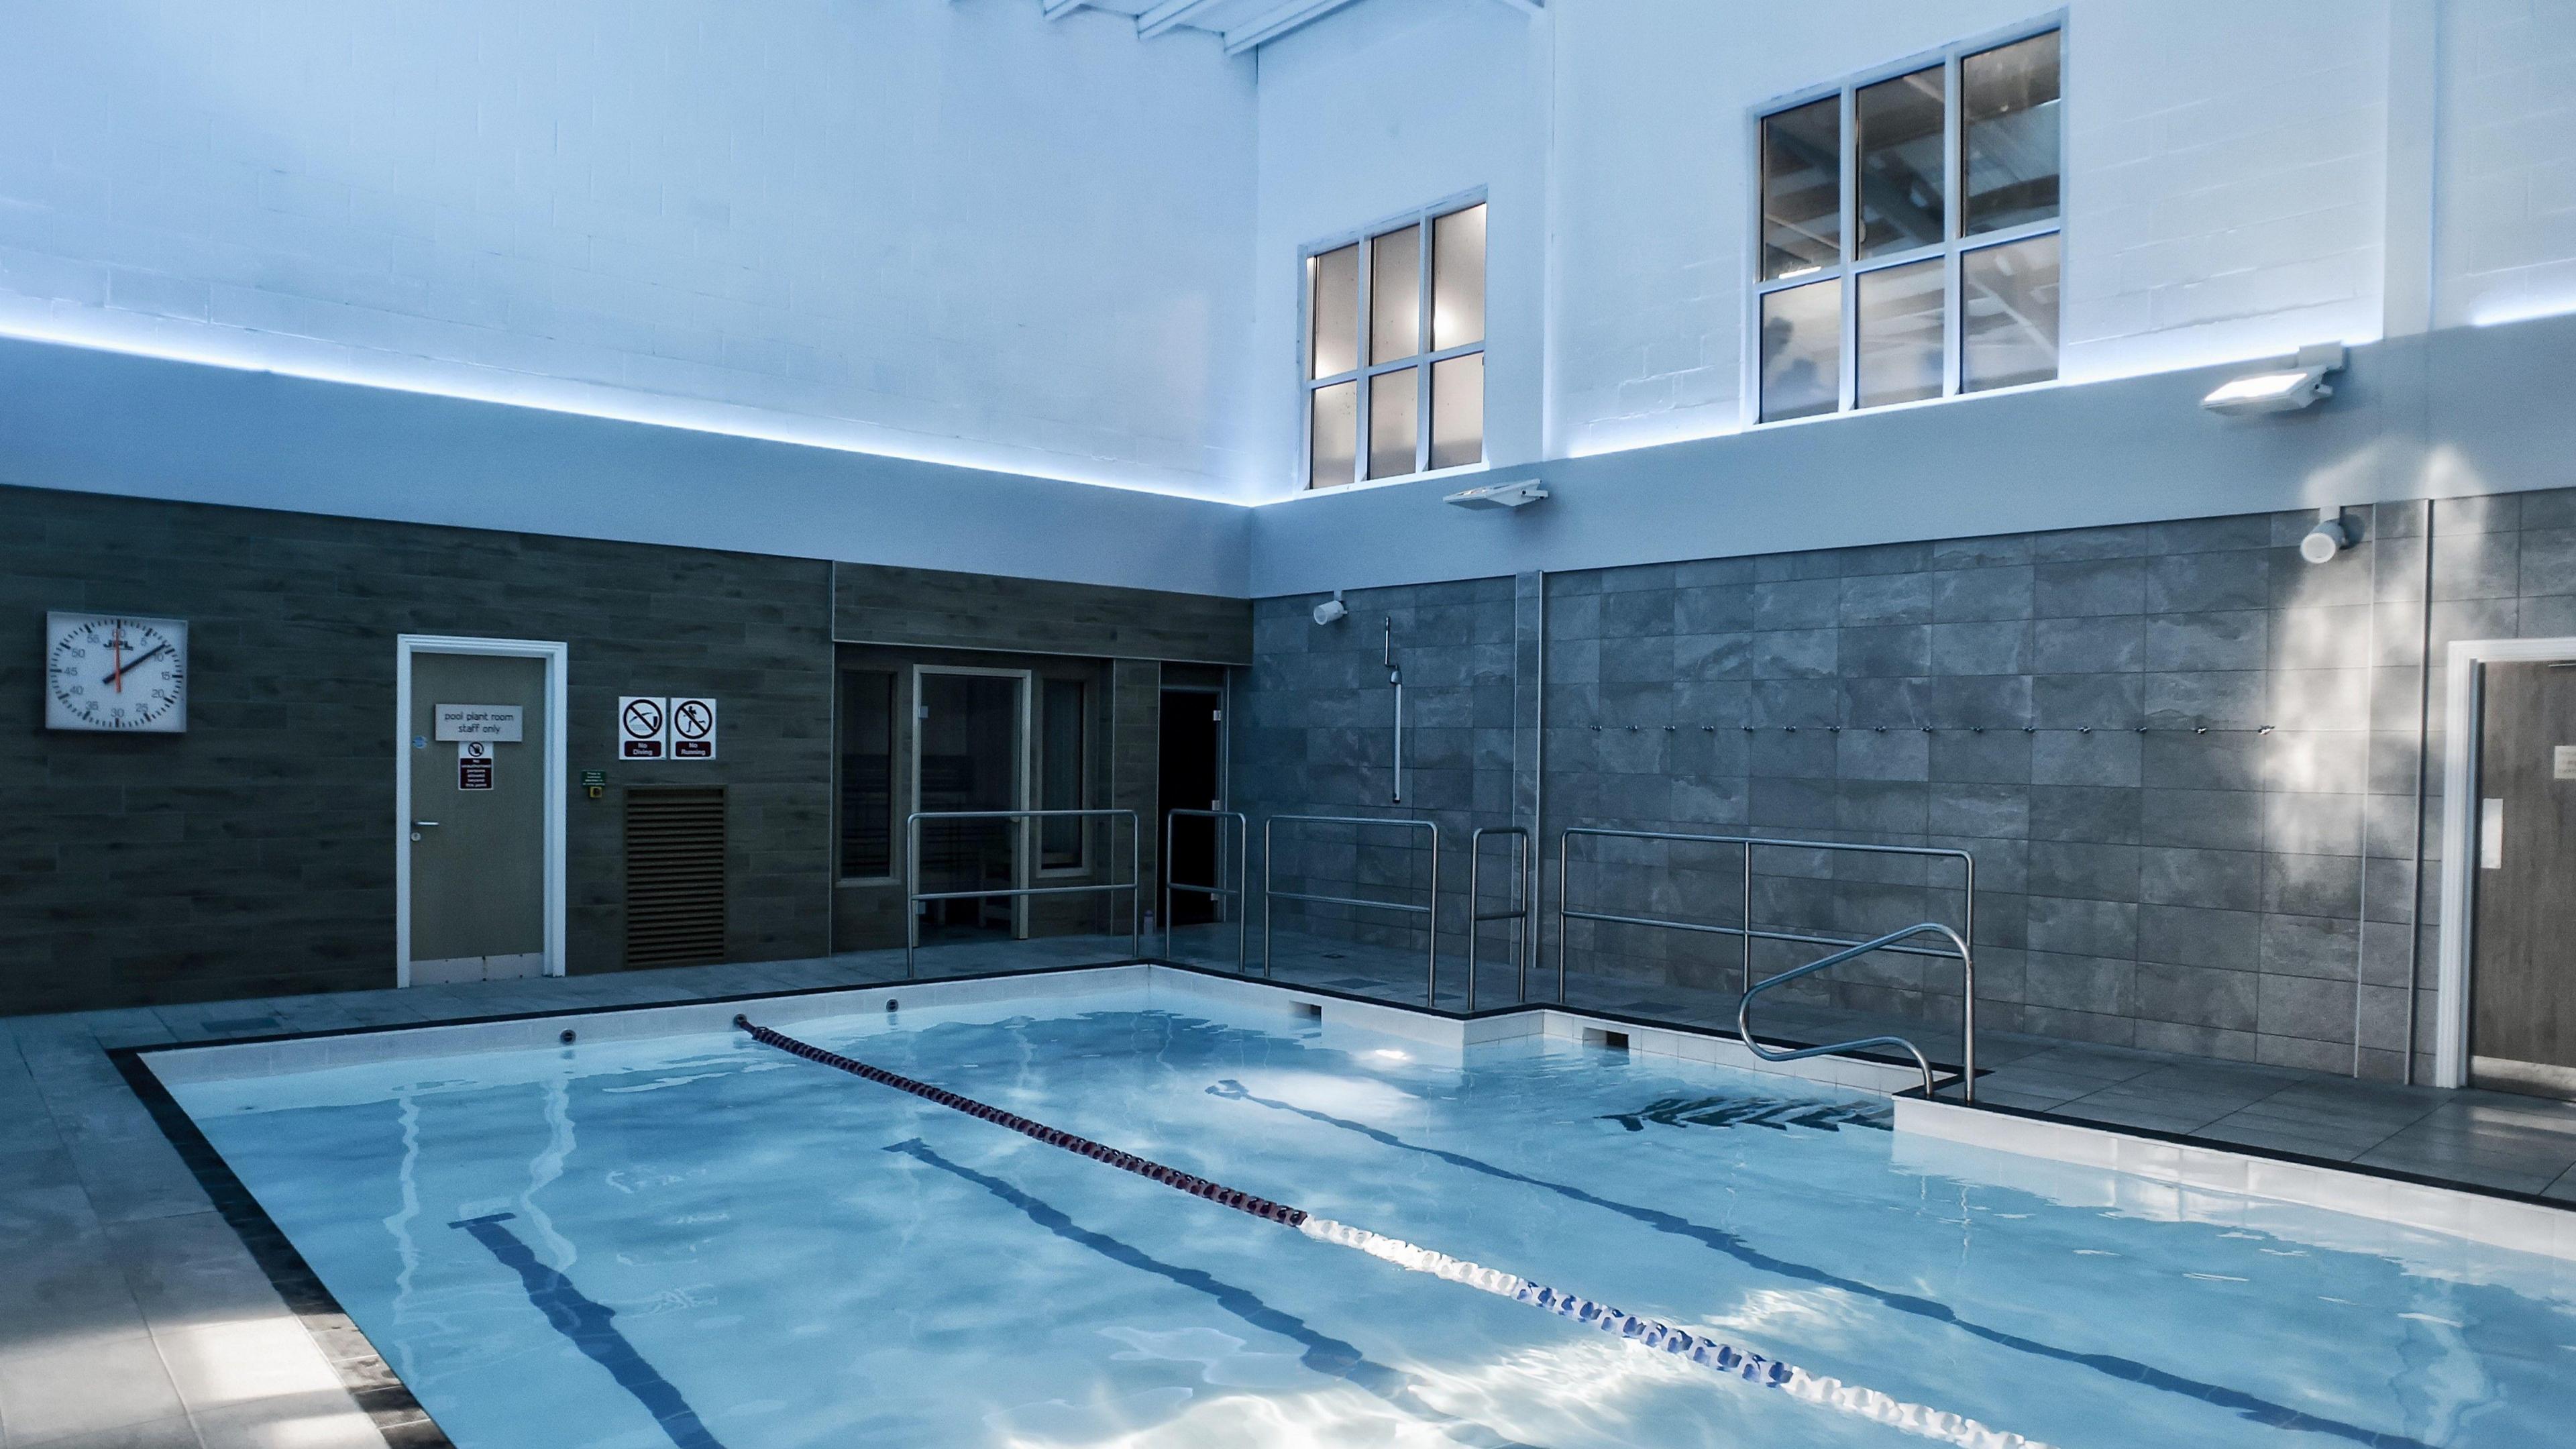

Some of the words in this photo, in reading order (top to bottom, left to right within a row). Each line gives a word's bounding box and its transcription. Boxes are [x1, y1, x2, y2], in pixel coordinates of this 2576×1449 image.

[87, 634, 99, 643] 55
[140, 637, 147, 645] 5
[71, 649, 85, 658] 50
[64, 667, 78, 676] 45
[162, 671, 170, 680] 15
[70, 686, 84, 694] 40
[152, 689, 164, 698] 20
[86, 701, 99, 710] 35
[136, 703, 149, 712] 25
[111, 708, 125, 718] 30
[445, 711, 463, 722] pool
[466, 711, 488, 721] plant
[491, 714, 514, 722] room
[458, 724, 480, 733] staff
[482, 724, 501, 734] only
